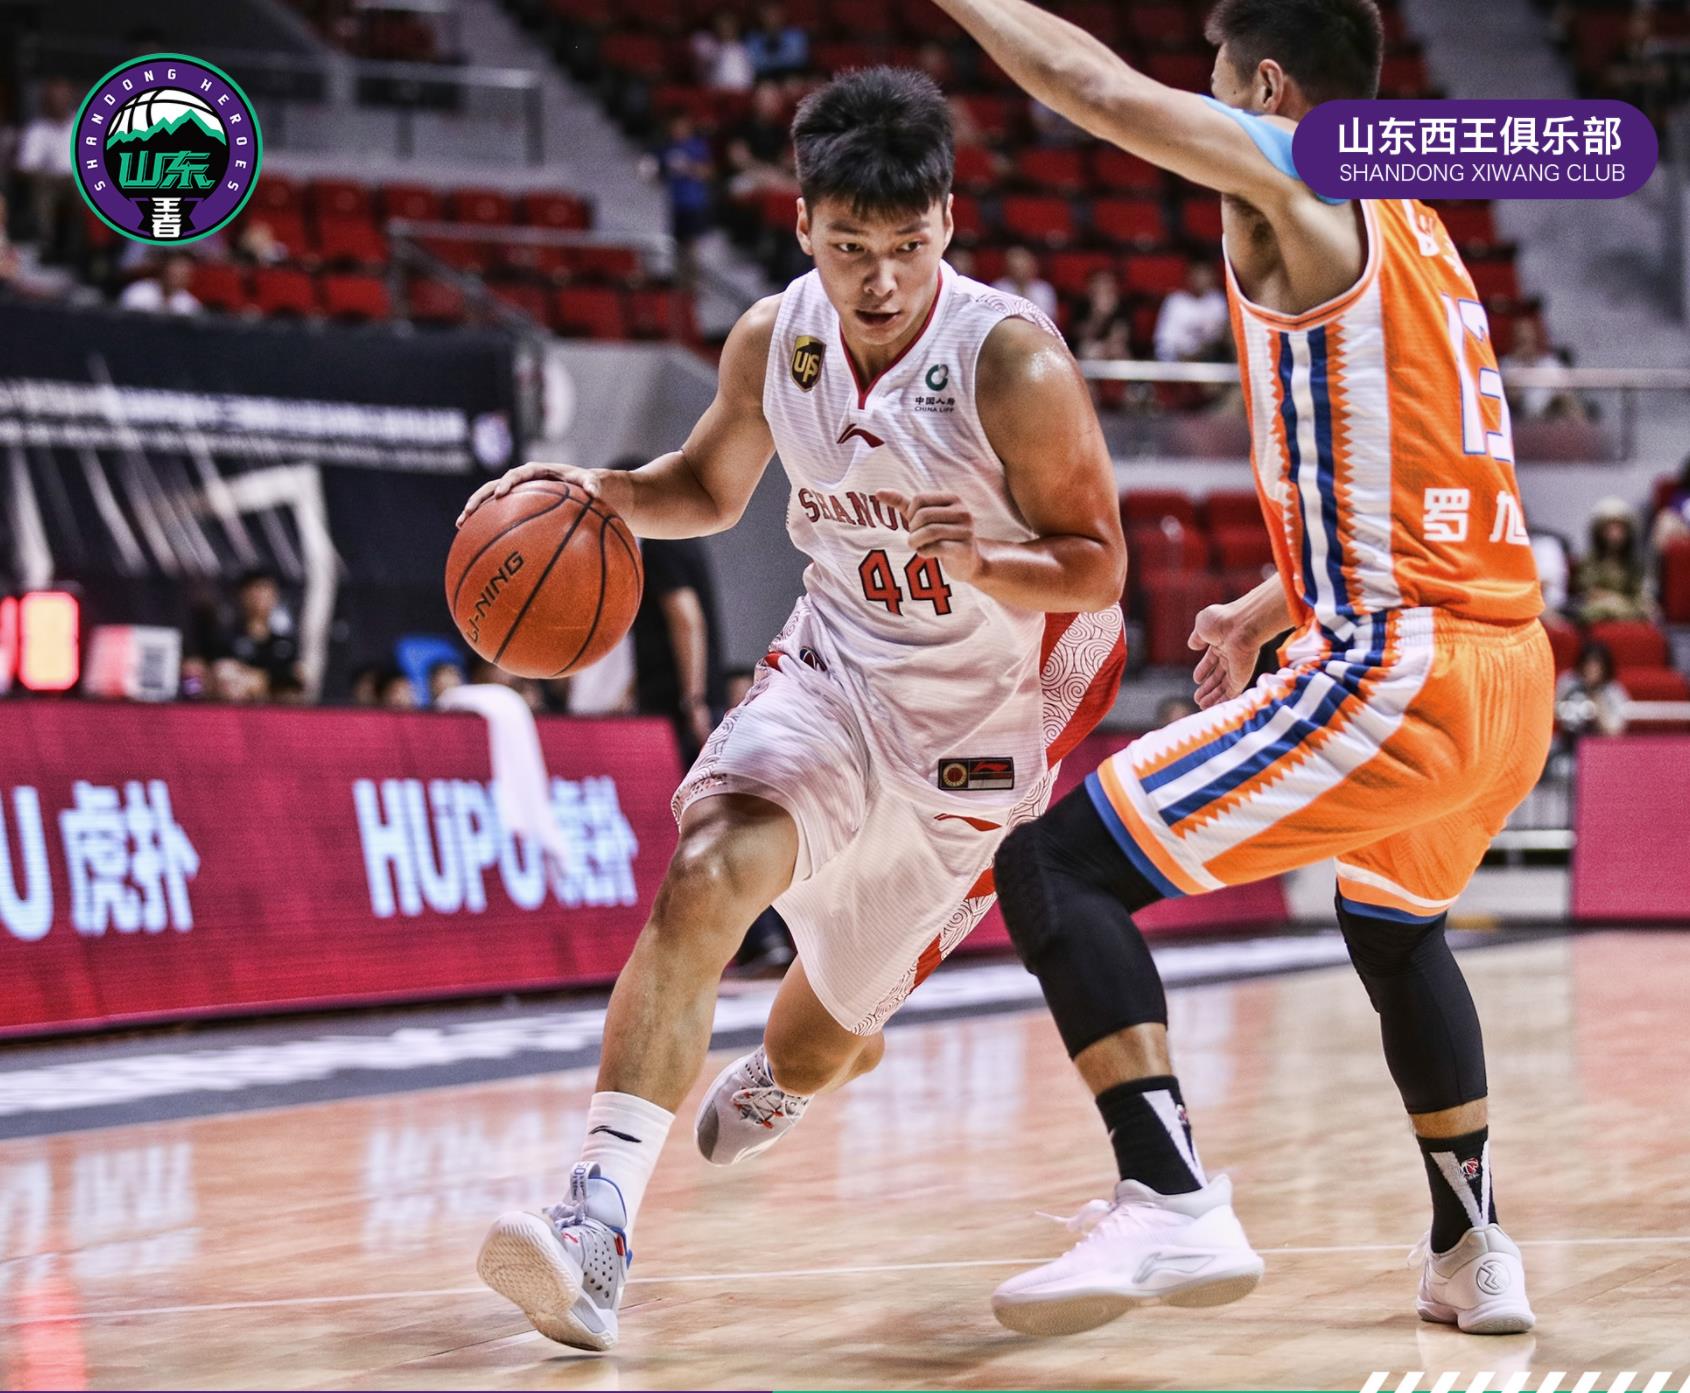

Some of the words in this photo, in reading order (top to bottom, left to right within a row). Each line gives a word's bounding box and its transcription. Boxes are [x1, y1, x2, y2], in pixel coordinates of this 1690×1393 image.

[793, 350, 820, 382] UPS
[466, 550, 524, 643] LI-NING
[858, 549, 952, 616] 44
